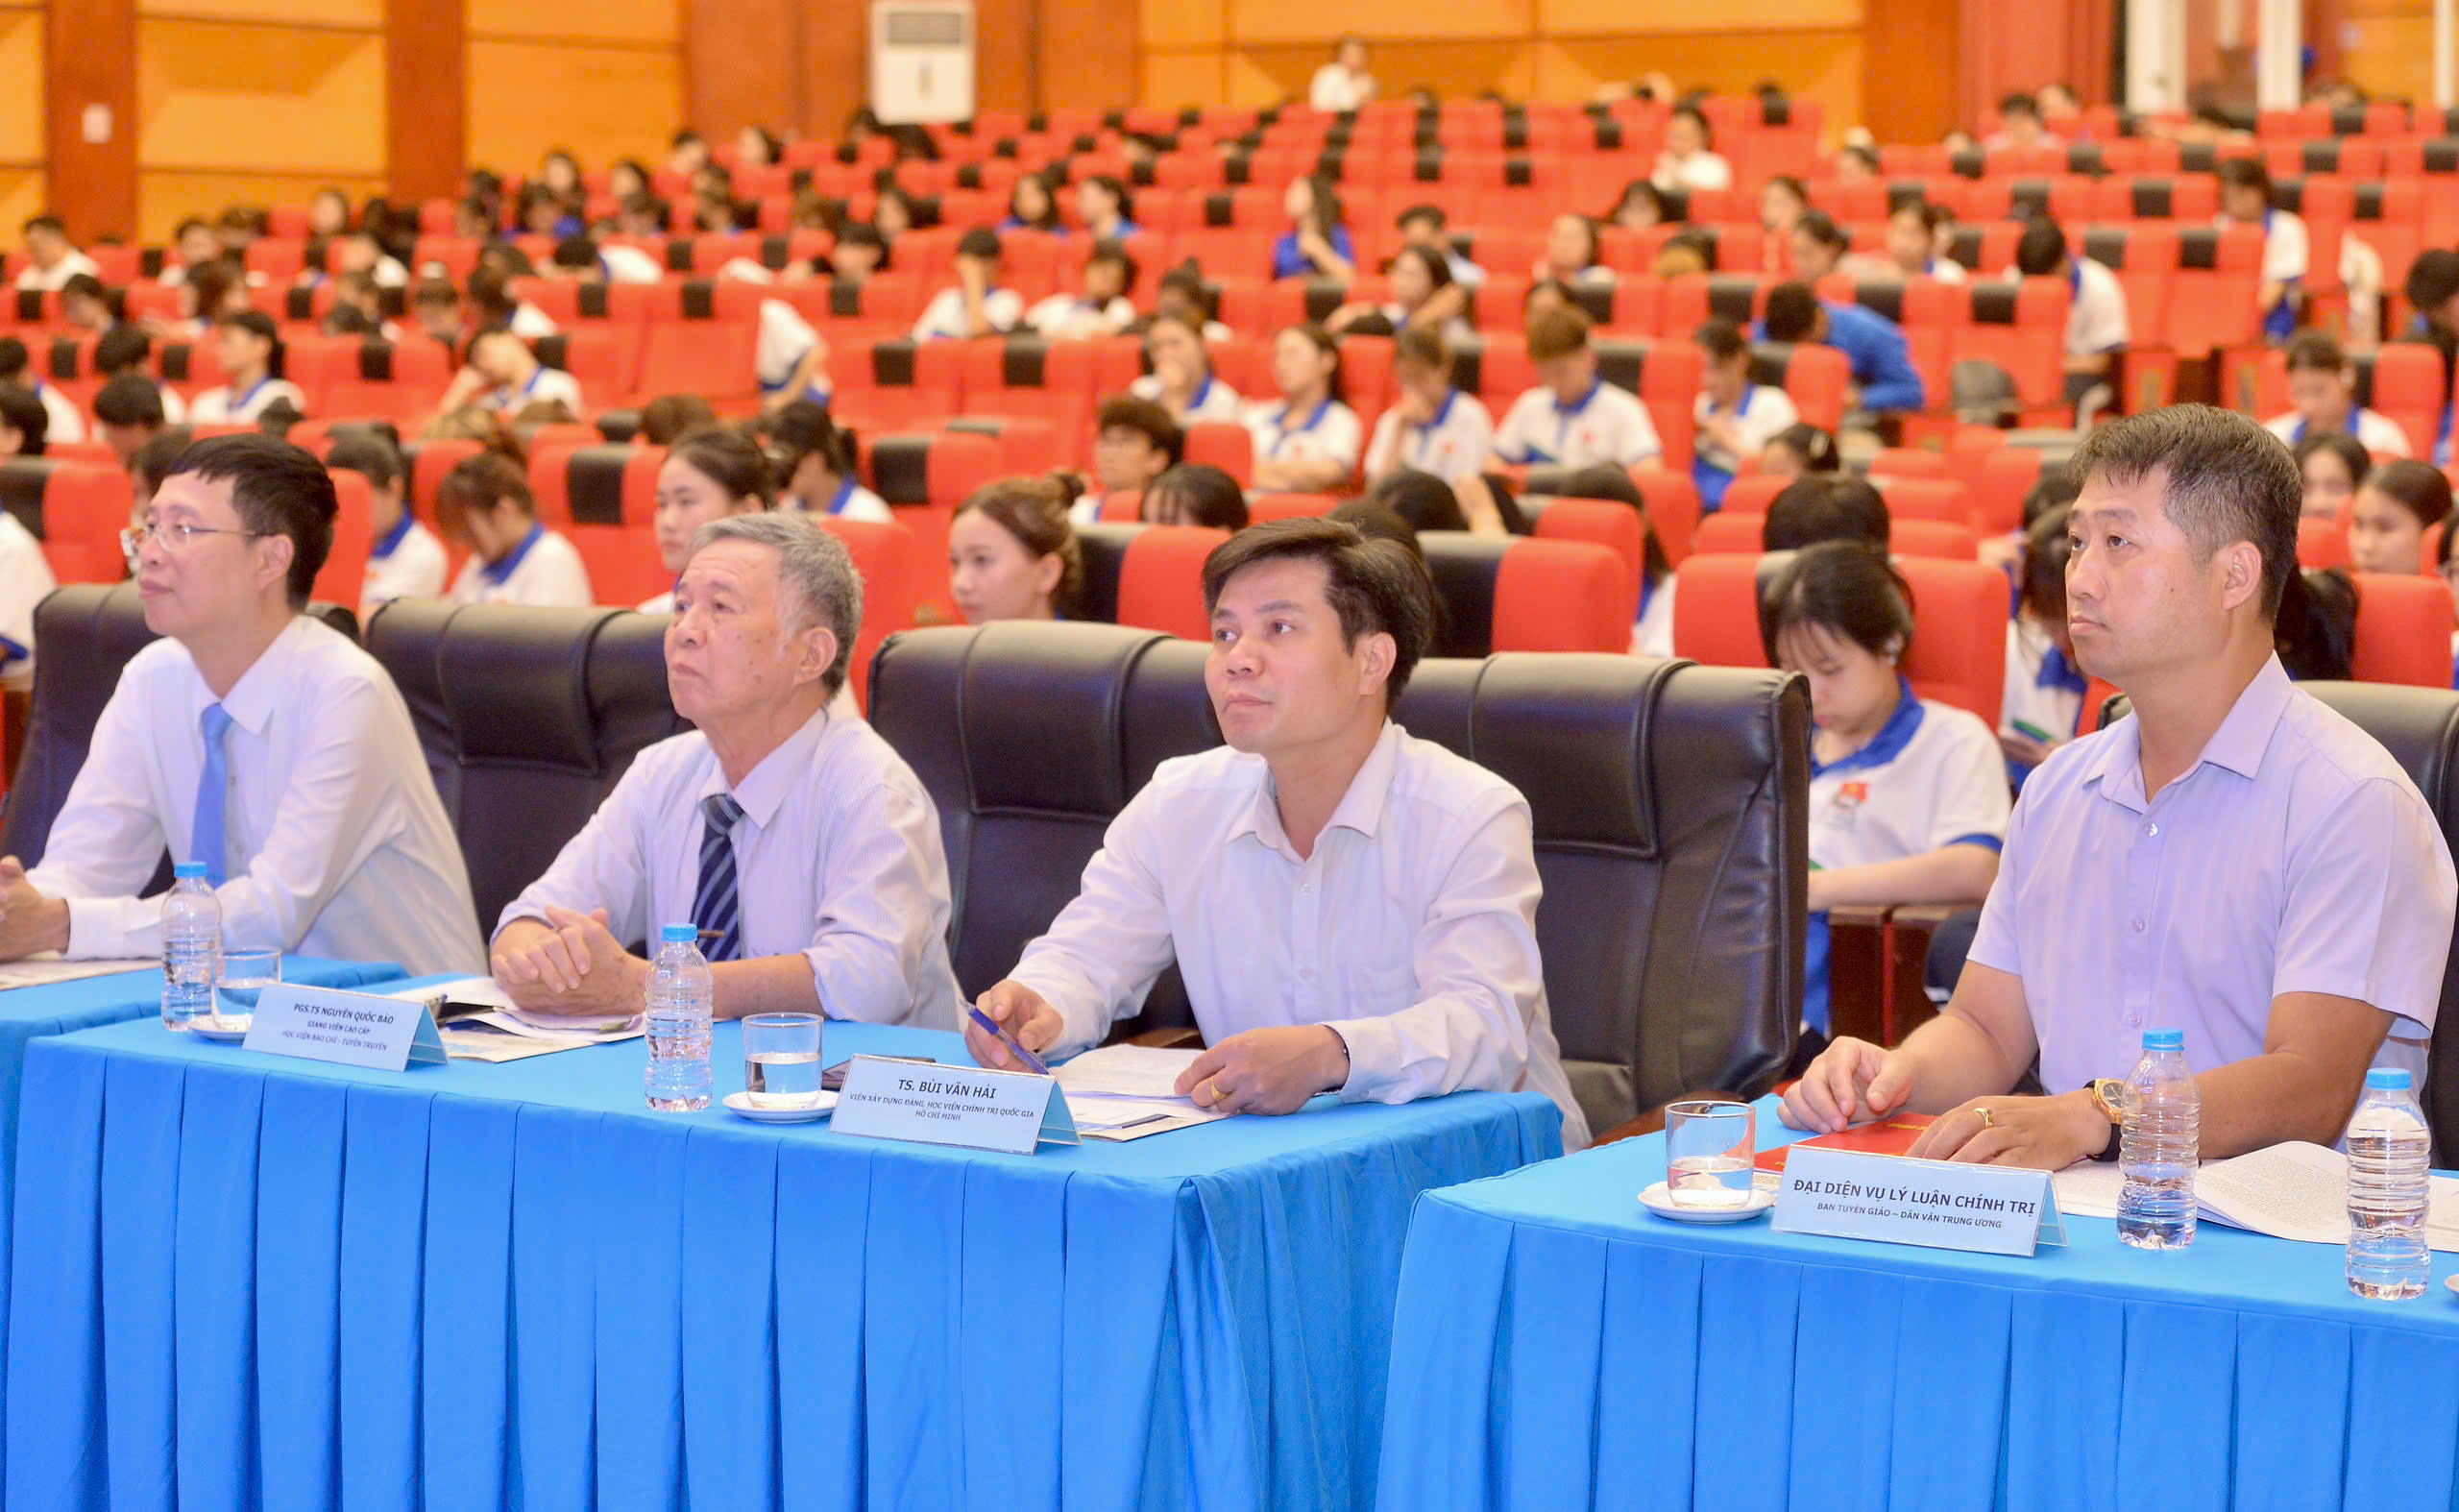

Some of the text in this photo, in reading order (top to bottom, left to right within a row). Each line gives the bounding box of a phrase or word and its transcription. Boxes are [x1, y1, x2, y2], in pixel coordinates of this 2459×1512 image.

[898, 1079, 915, 1091] TS.
[944, 1081, 970, 1096] VĂN
[940, 1113, 962, 1122] MINH
[1020, 1110, 1035, 1118] GIA
[1793, 1179, 1821, 1195] ĐẠI
[1824, 1180, 1862, 1199] DIỆN
[1865, 1186, 1886, 1203] VỤ
[1888, 1185, 1908, 1202] LÝ
[1911, 1189, 1951, 1208] LUẬN
[1954, 1193, 2006, 1212] CHÍNH
[2009, 1200, 2036, 1218] TRỊ
[1816, 1202, 1836, 1211] BAN
[1941, 1215, 1973, 1226] TRUNG
